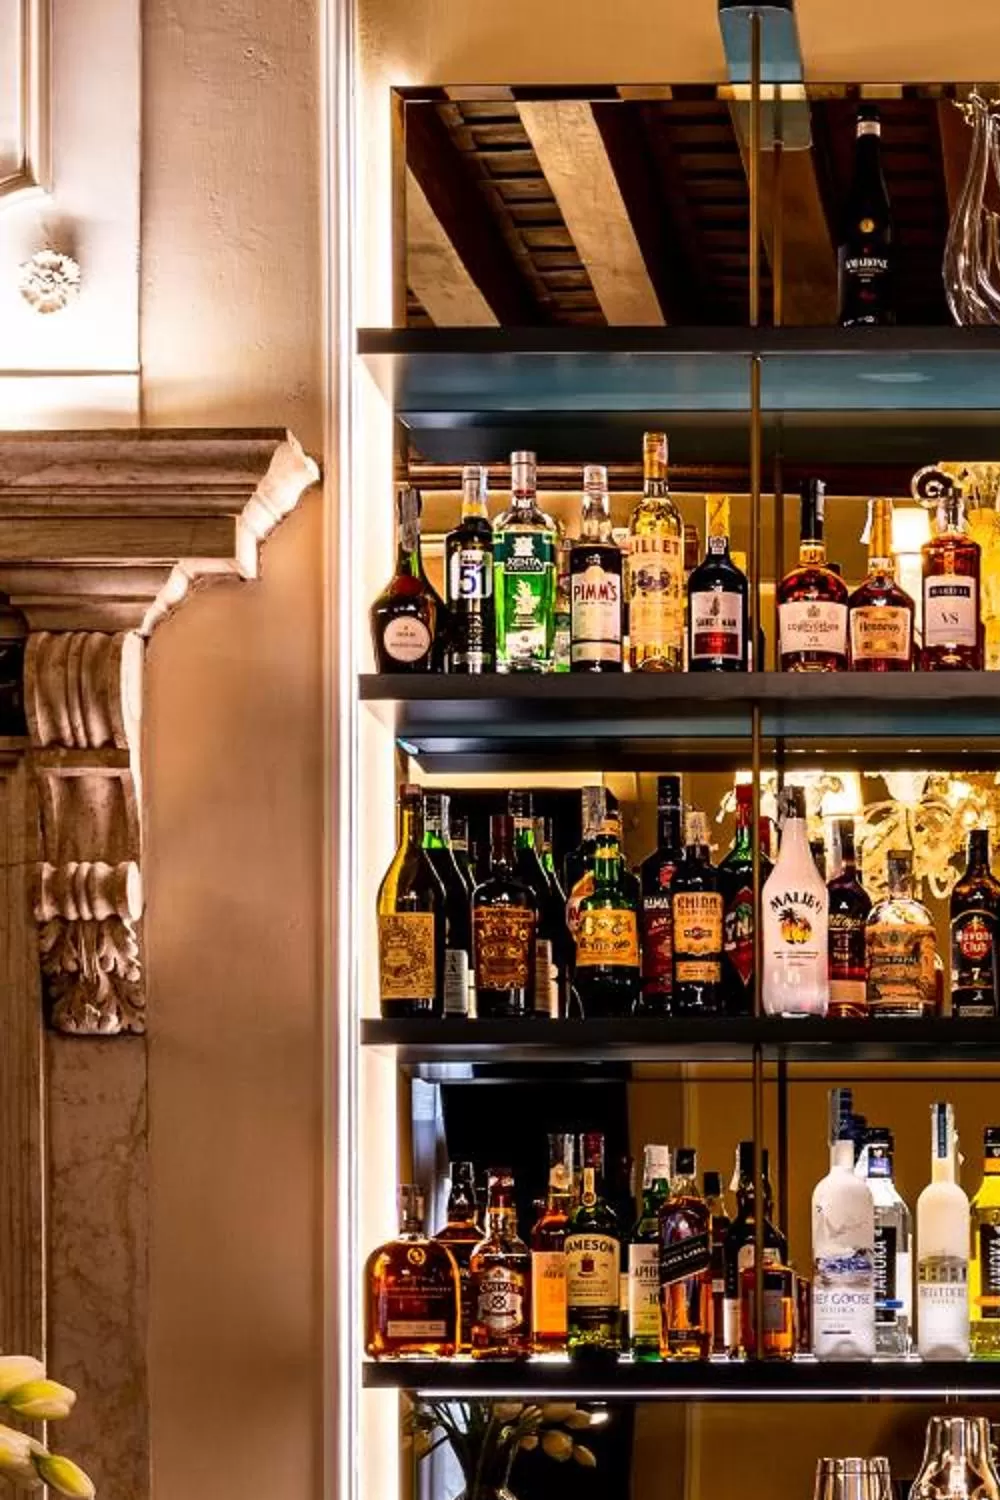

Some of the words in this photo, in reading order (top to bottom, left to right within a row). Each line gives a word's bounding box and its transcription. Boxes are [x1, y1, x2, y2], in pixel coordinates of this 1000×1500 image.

[460, 566, 487, 595] 51
[574, 582, 617, 601] PIMM'S
[941, 612, 959, 624] VS
[770, 892, 823, 914] MALIBU
[971, 967, 981, 980] 7
[831, 1293, 870, 1305] GOOSE
